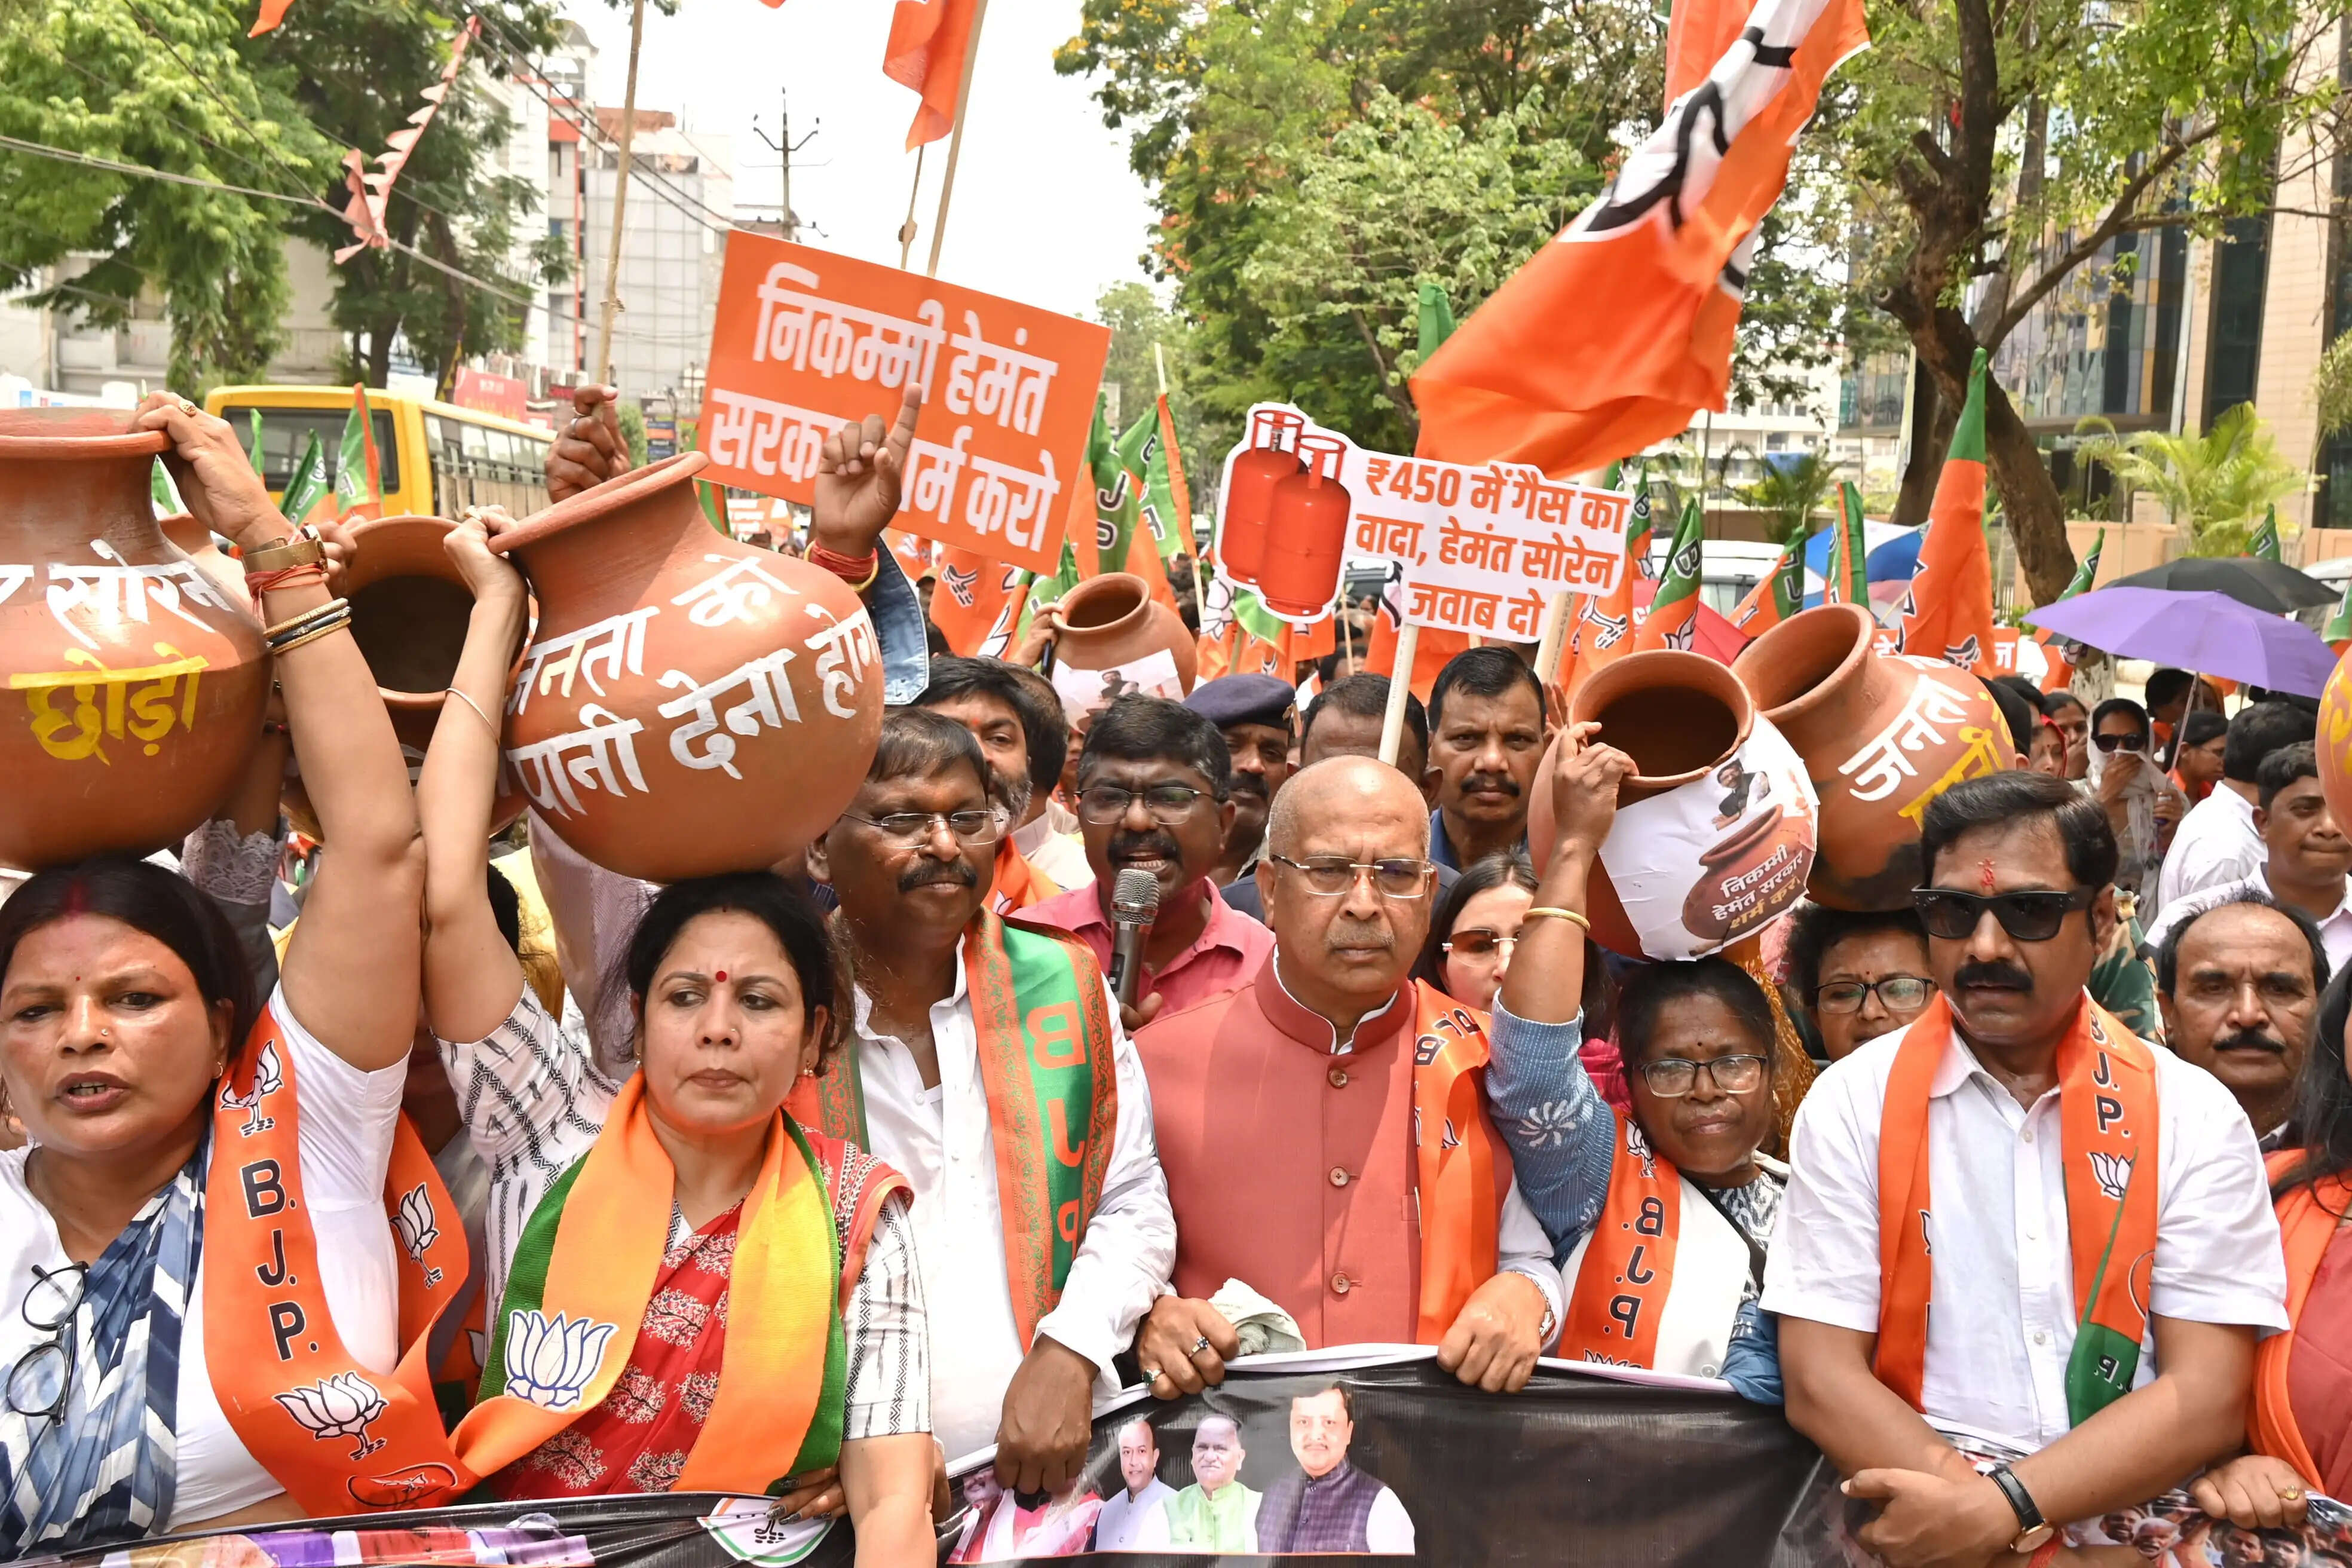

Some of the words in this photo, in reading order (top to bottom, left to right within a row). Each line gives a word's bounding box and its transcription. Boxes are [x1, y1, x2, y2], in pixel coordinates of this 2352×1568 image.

[752, 262, 947, 405] निकम्मी
[944, 310, 1058, 437] हेमंत
[708, 388, 852, 483] सरक
[966, 449, 1061, 552] करो
[1366, 458, 1461, 508] ₹450
[1471, 464, 1512, 514] में
[1511, 467, 1575, 525] गैस
[1581, 492, 1630, 534] का
[1355, 514, 1428, 566] वादा,
[1438, 516, 1517, 574] हेमंत
[1521, 532, 1619, 589] सोरेन
[670, 554, 800, 627] को
[1409, 581, 1502, 630] जवाब
[1507, 589, 1546, 637] दो
[506, 703, 650, 820] पानी
[656, 648, 803, 779] देना
[1838, 674, 1971, 801] जनता
[1711, 890, 1756, 921] हेमंत
[1759, 850, 1803, 894] सरकार
[1720, 844, 1788, 898] निकम्मी
